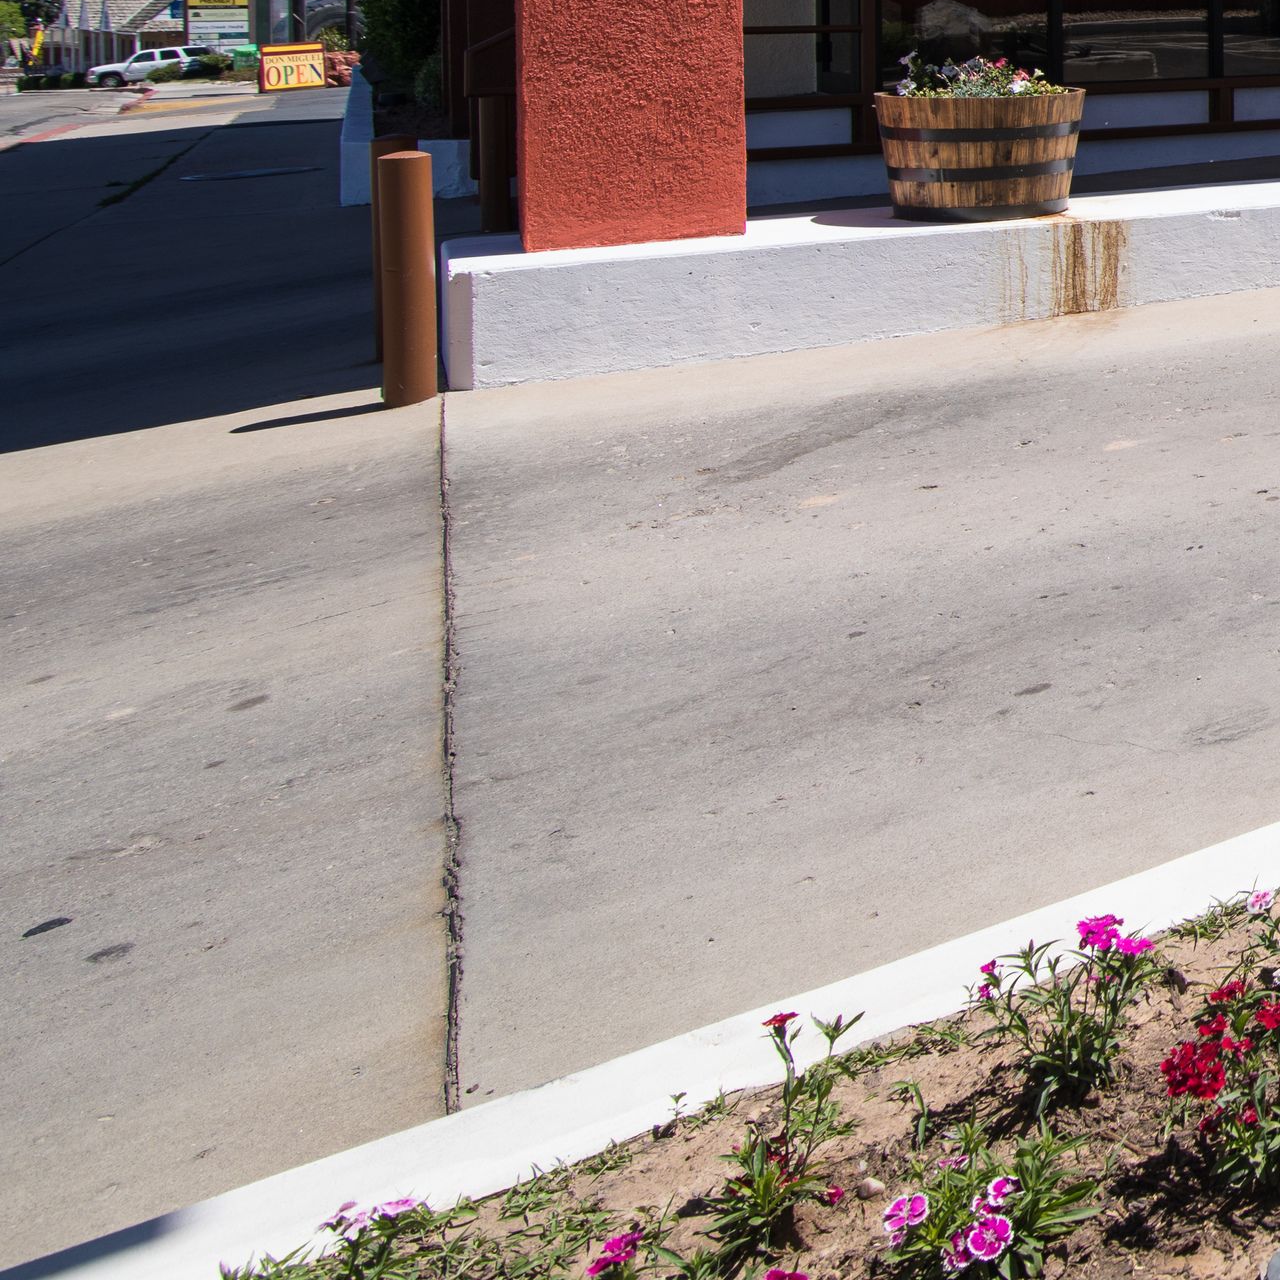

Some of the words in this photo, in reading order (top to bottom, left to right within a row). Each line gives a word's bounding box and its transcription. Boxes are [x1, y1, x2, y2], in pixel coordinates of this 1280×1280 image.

[265, 56, 285, 65] DON
[286, 53, 321, 63] MIGUEL
[266, 62, 323, 87] OPEN
